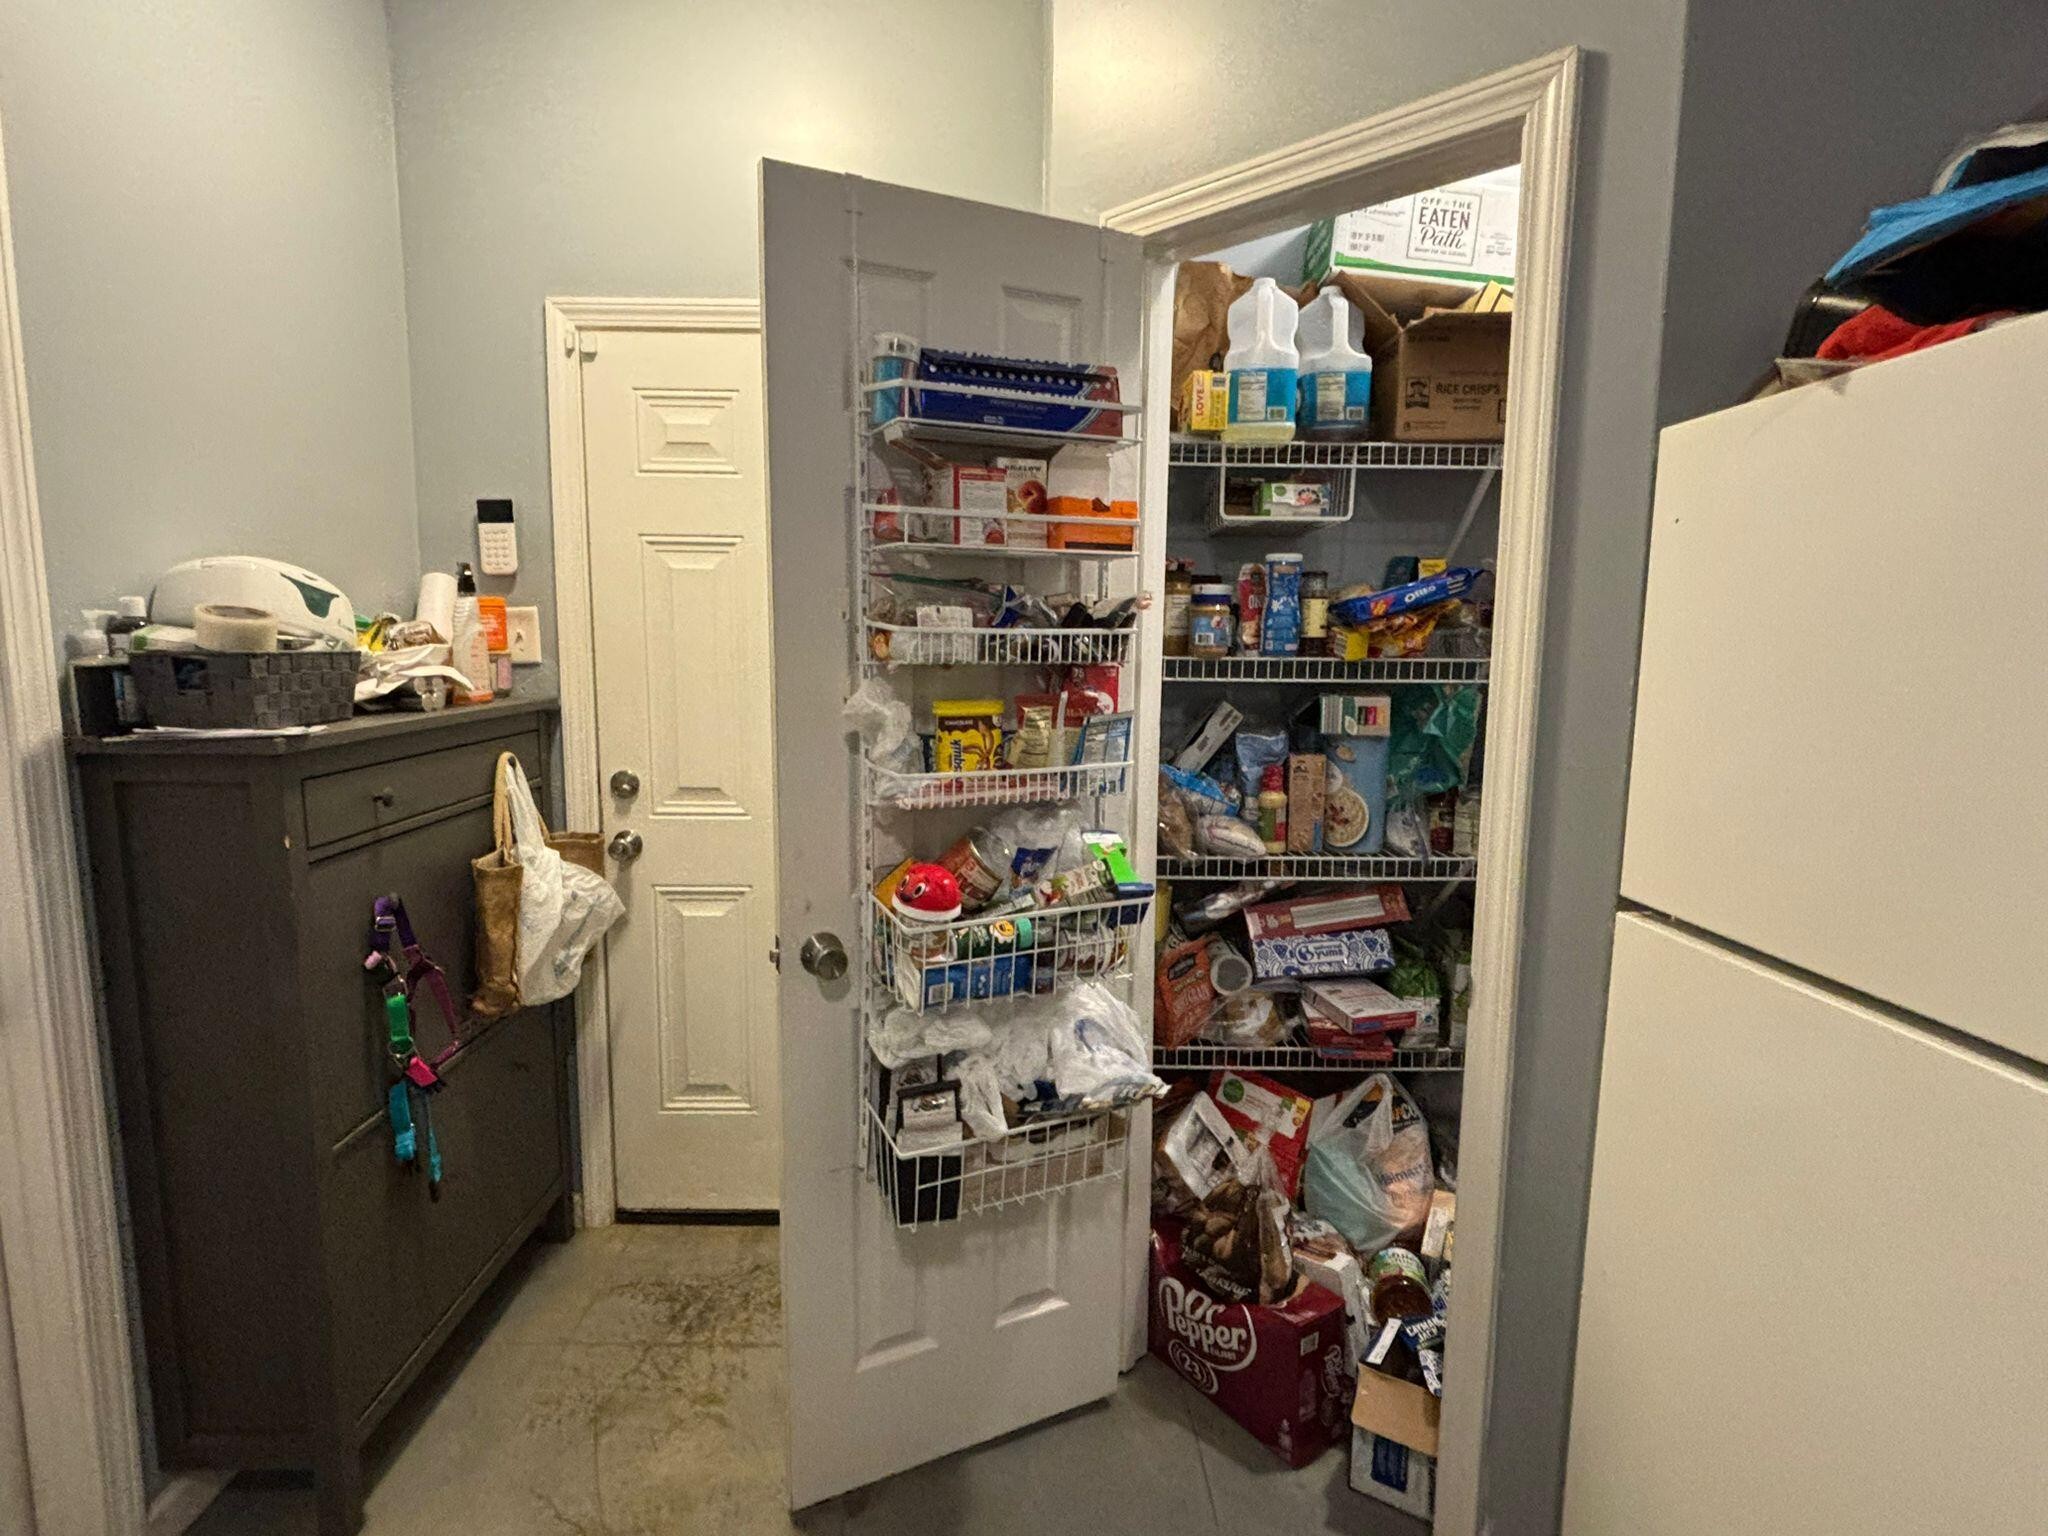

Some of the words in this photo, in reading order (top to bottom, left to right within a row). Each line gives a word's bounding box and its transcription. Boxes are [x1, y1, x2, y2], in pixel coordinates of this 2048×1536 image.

[1419, 206, 1470, 230] EATEN
[1420, 226, 1465, 249] Path
[1196, 388, 1205, 417] LOVE
[1314, 949, 1344, 960] yums
[1159, 1276, 1248, 1353] Pepper
[1184, 1288, 1226, 1326] Dr
